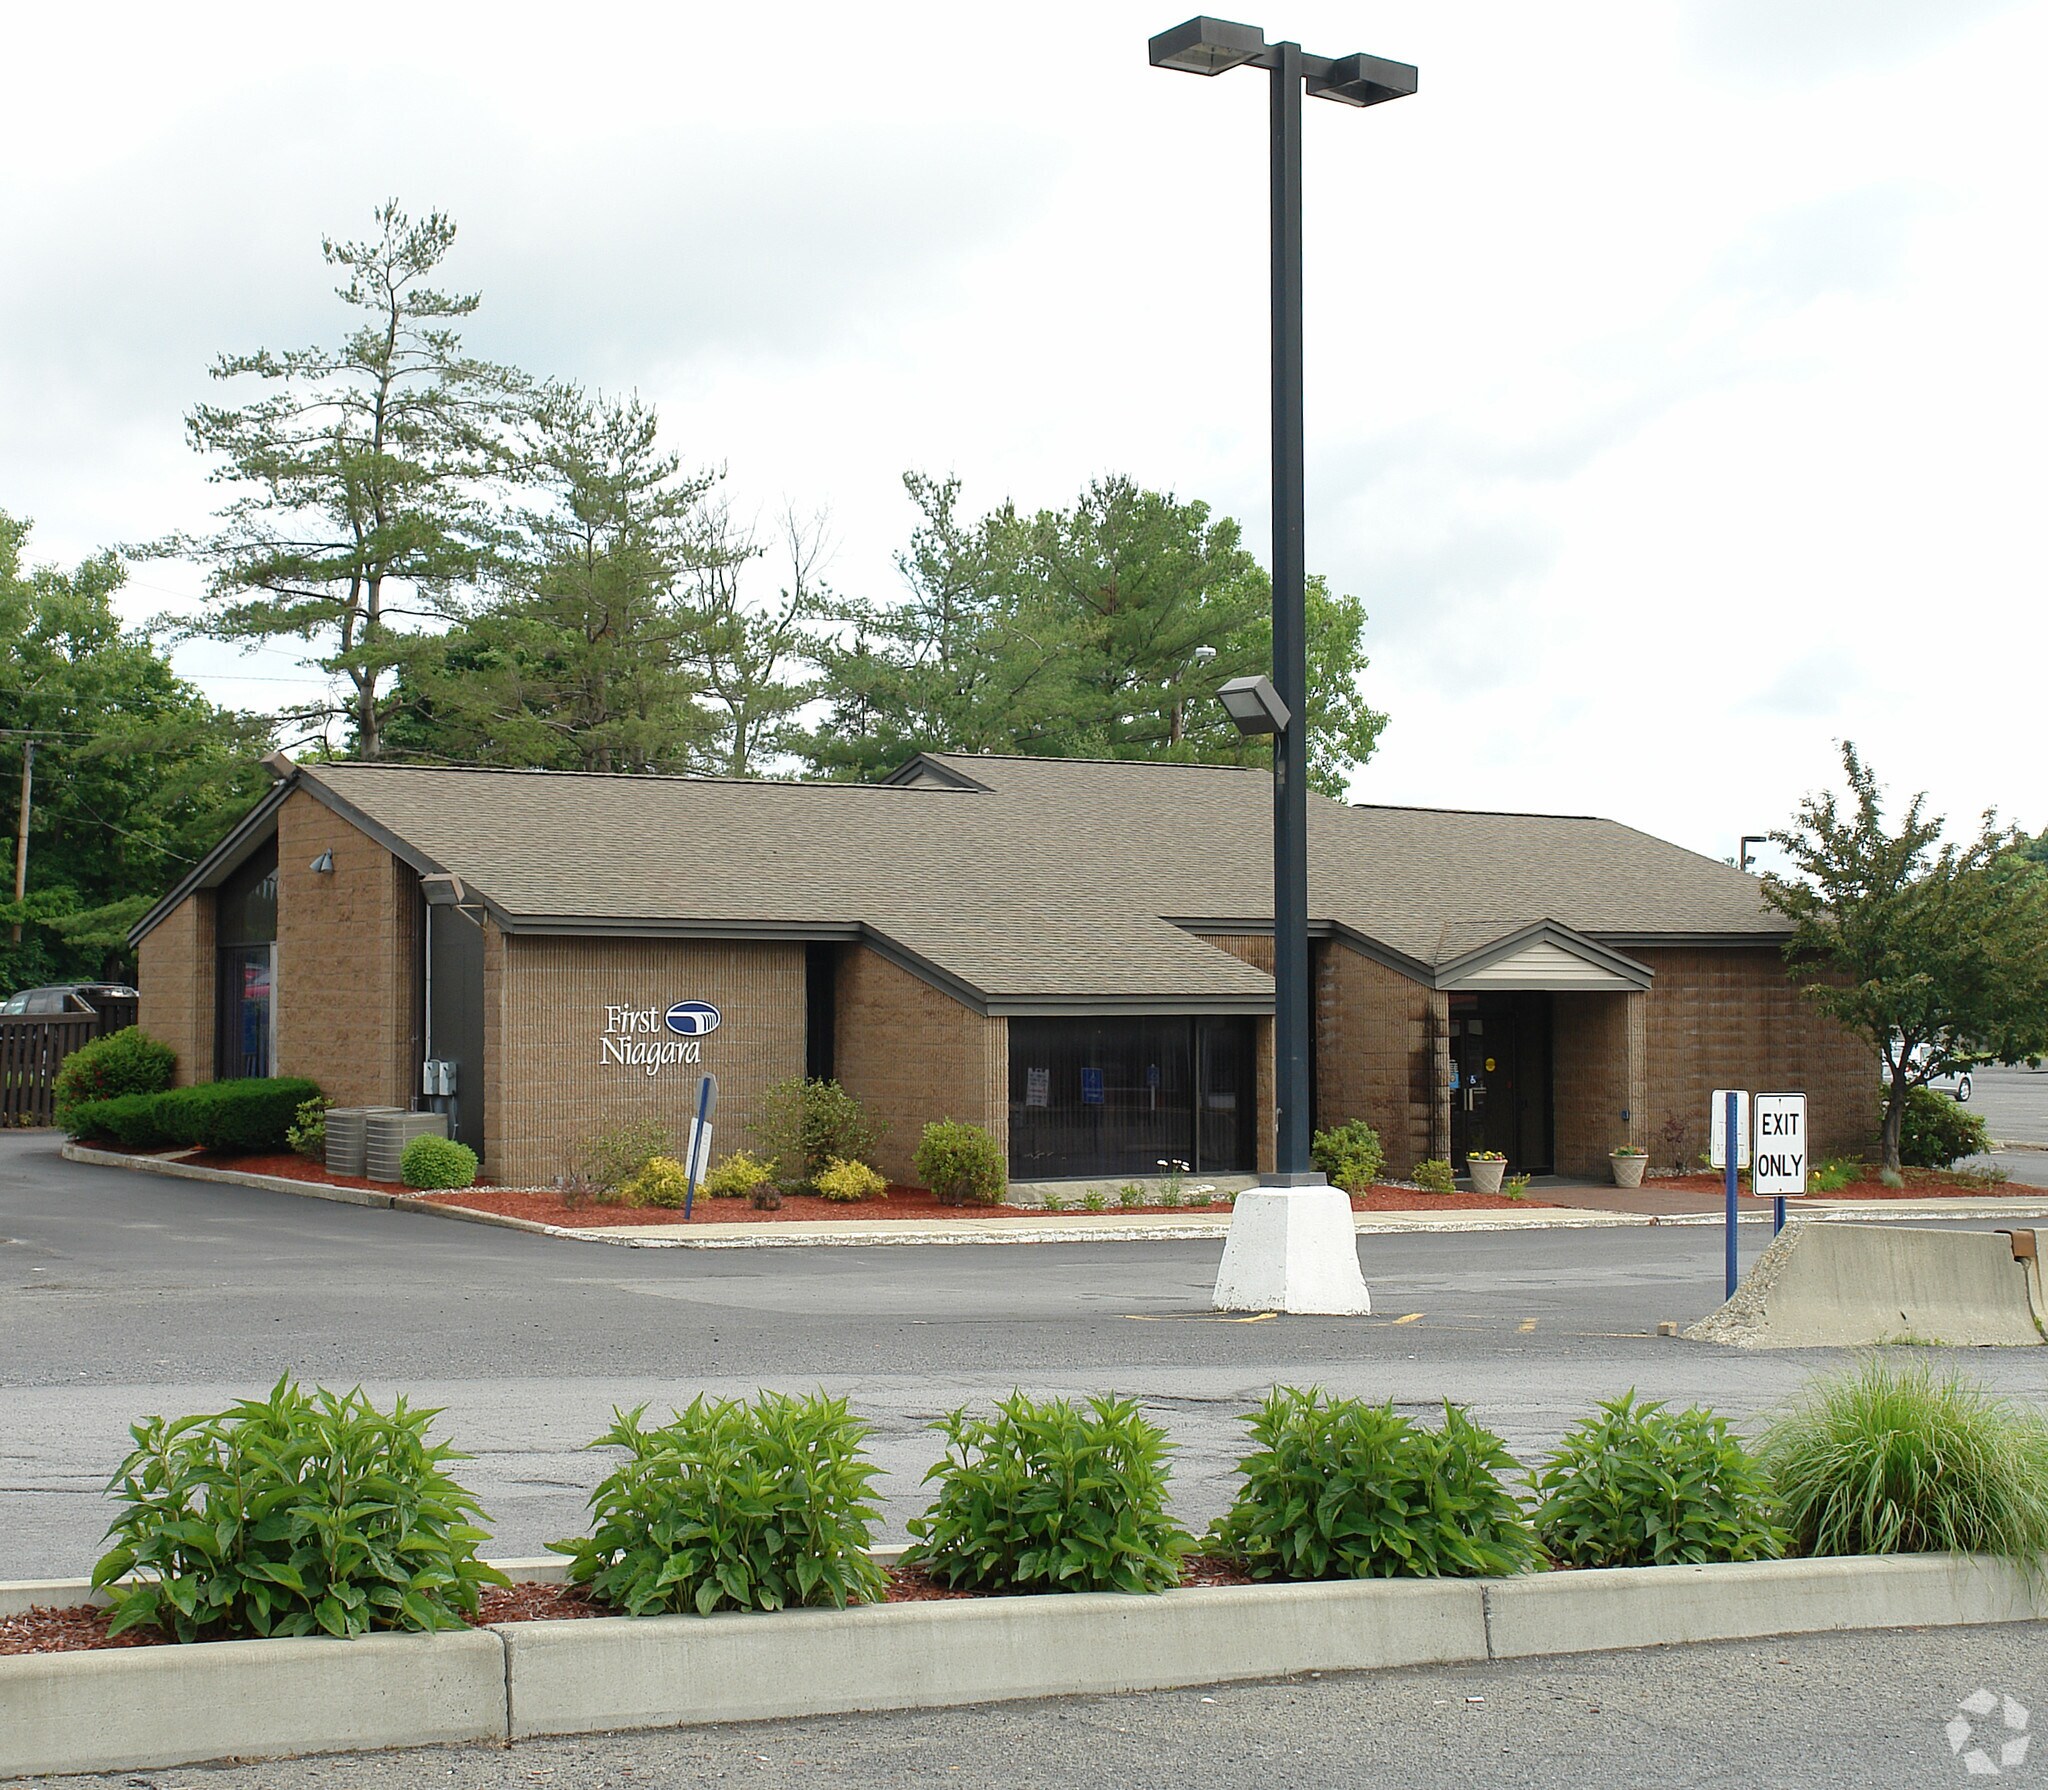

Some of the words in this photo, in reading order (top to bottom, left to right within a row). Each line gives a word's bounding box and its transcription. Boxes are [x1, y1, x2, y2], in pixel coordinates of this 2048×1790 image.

[604, 1003, 660, 1033] First
[600, 1036, 701, 1076] Niagara
[1762, 1113, 1799, 1135] EXIT
[1758, 1154, 1803, 1177] ONLY
